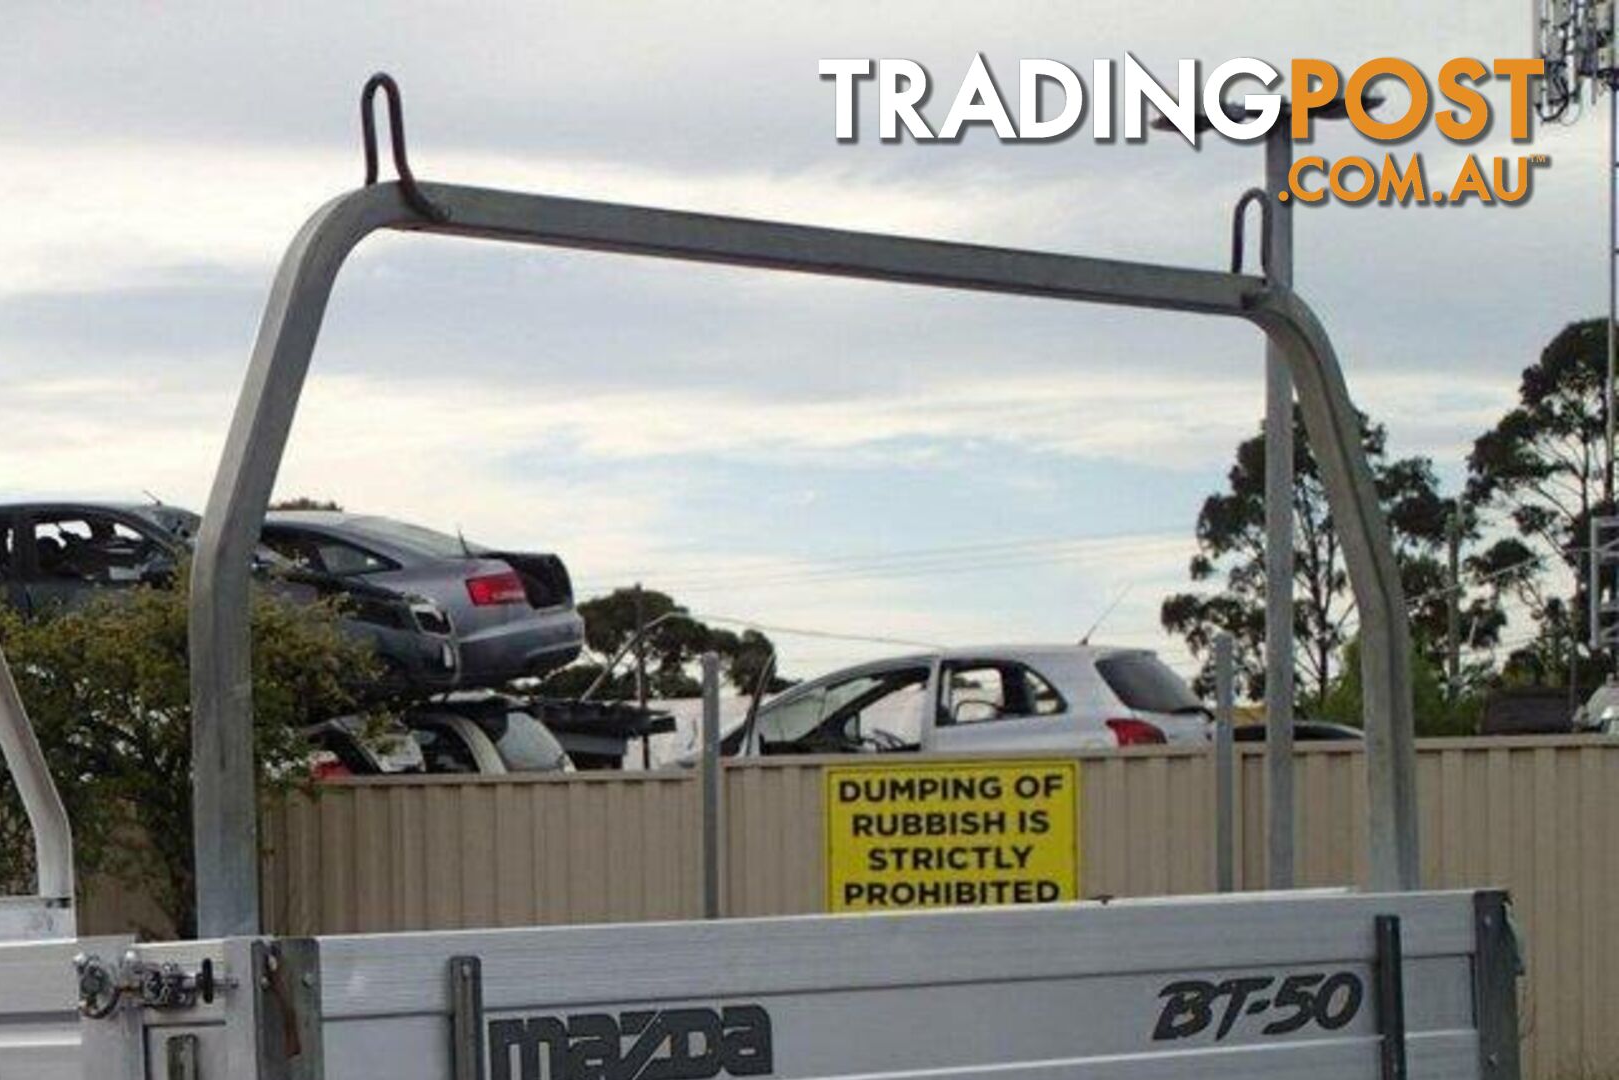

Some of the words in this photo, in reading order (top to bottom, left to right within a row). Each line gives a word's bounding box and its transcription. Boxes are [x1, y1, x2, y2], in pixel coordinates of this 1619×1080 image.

[839, 776, 1003, 803] DUMPING
[1014, 774, 1064, 798] OF
[852, 811, 1006, 837] RUBBISH
[1019, 810, 1050, 833] IS
[868, 846, 1035, 871] STRICTLY
[844, 880, 1061, 905] PROHIBITED
[1152, 971, 1364, 1042] BT-50
